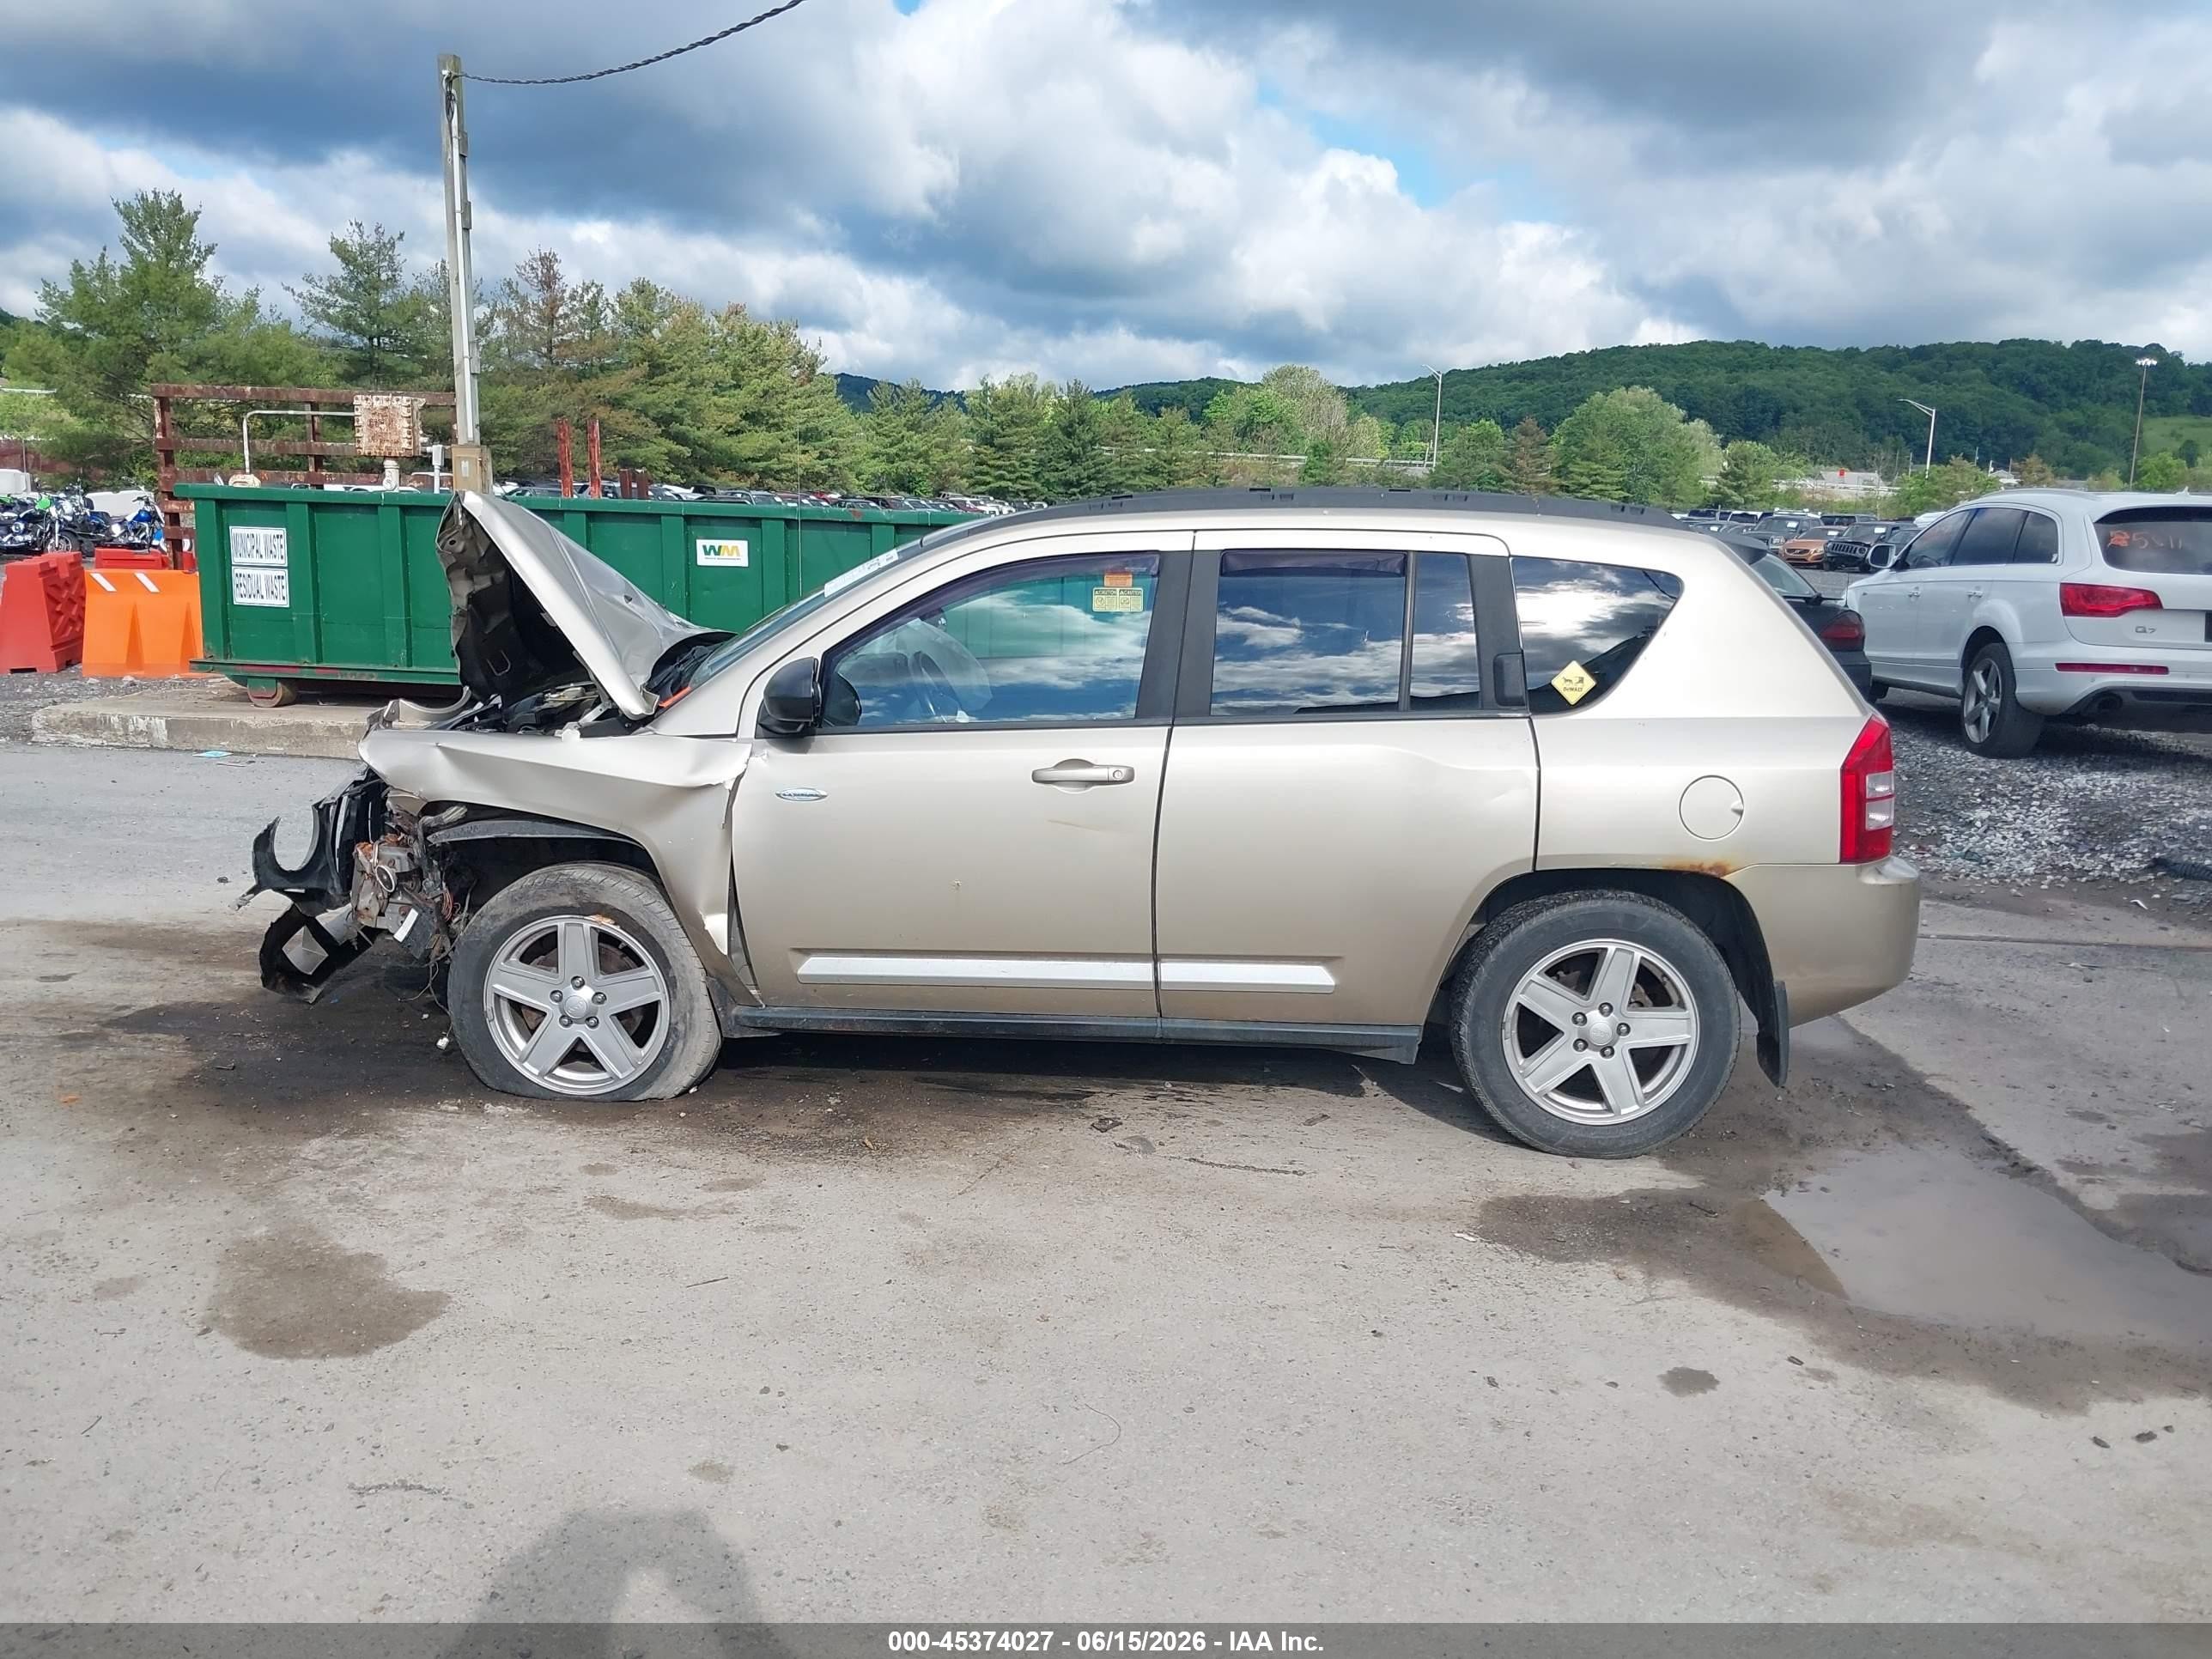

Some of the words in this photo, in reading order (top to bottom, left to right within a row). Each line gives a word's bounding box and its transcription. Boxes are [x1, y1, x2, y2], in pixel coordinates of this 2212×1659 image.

[233, 532, 263, 559] MUNICIPAL
[264, 534, 284, 561] WASTE
[702, 544, 741, 556] WM
[234, 573, 264, 599] RESIDUAL
[264, 574, 286, 601] WASTE
[2135, 625, 2157, 634] Q7
